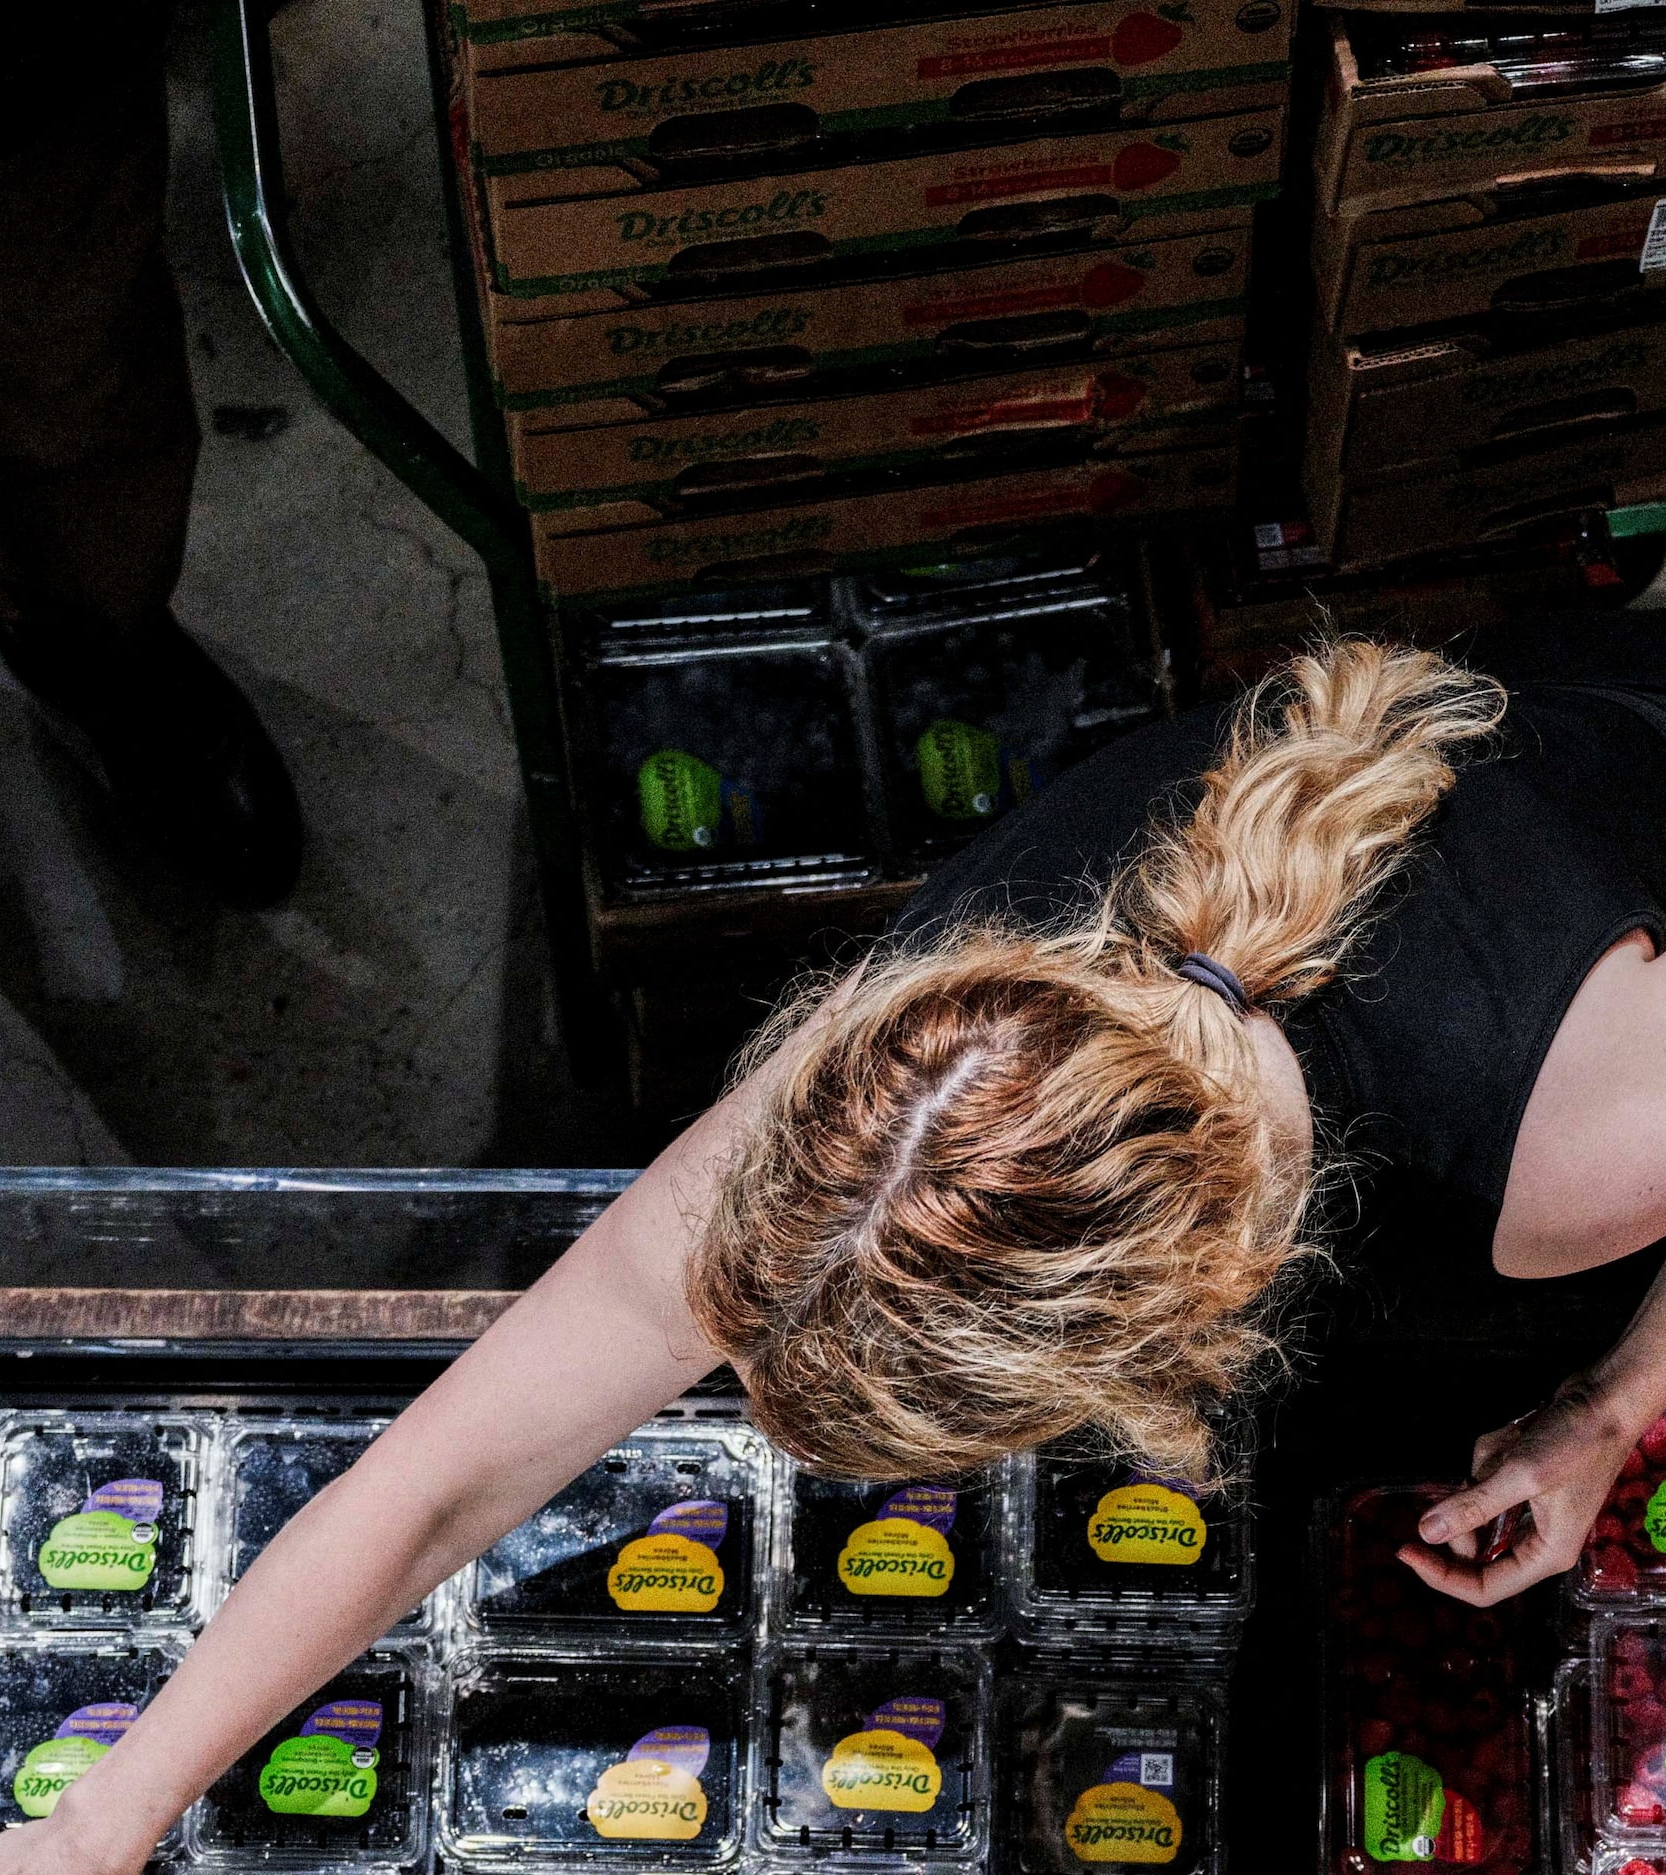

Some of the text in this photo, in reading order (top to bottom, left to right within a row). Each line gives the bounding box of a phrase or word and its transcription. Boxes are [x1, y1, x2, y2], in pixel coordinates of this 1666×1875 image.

[947, 21, 1100, 51] Strawberries
[594, 57, 816, 112] Driscoll's
[1364, 116, 1579, 163] Driscoll's
[953, 151, 1100, 182] Strawberries
[615, 191, 827, 241] Driscoll's
[605, 308, 812, 355] Driscoll's
[1091, 1522, 1198, 1548] Driscoll's
[46, 1548, 146, 1576] Driscoll's
[843, 1558, 948, 1582] Driscoll's
[615, 1572, 717, 1596] Driscoll's
[266, 1769, 370, 1799] Driscoll's
[1069, 1821, 1175, 1848] Driscoll's
